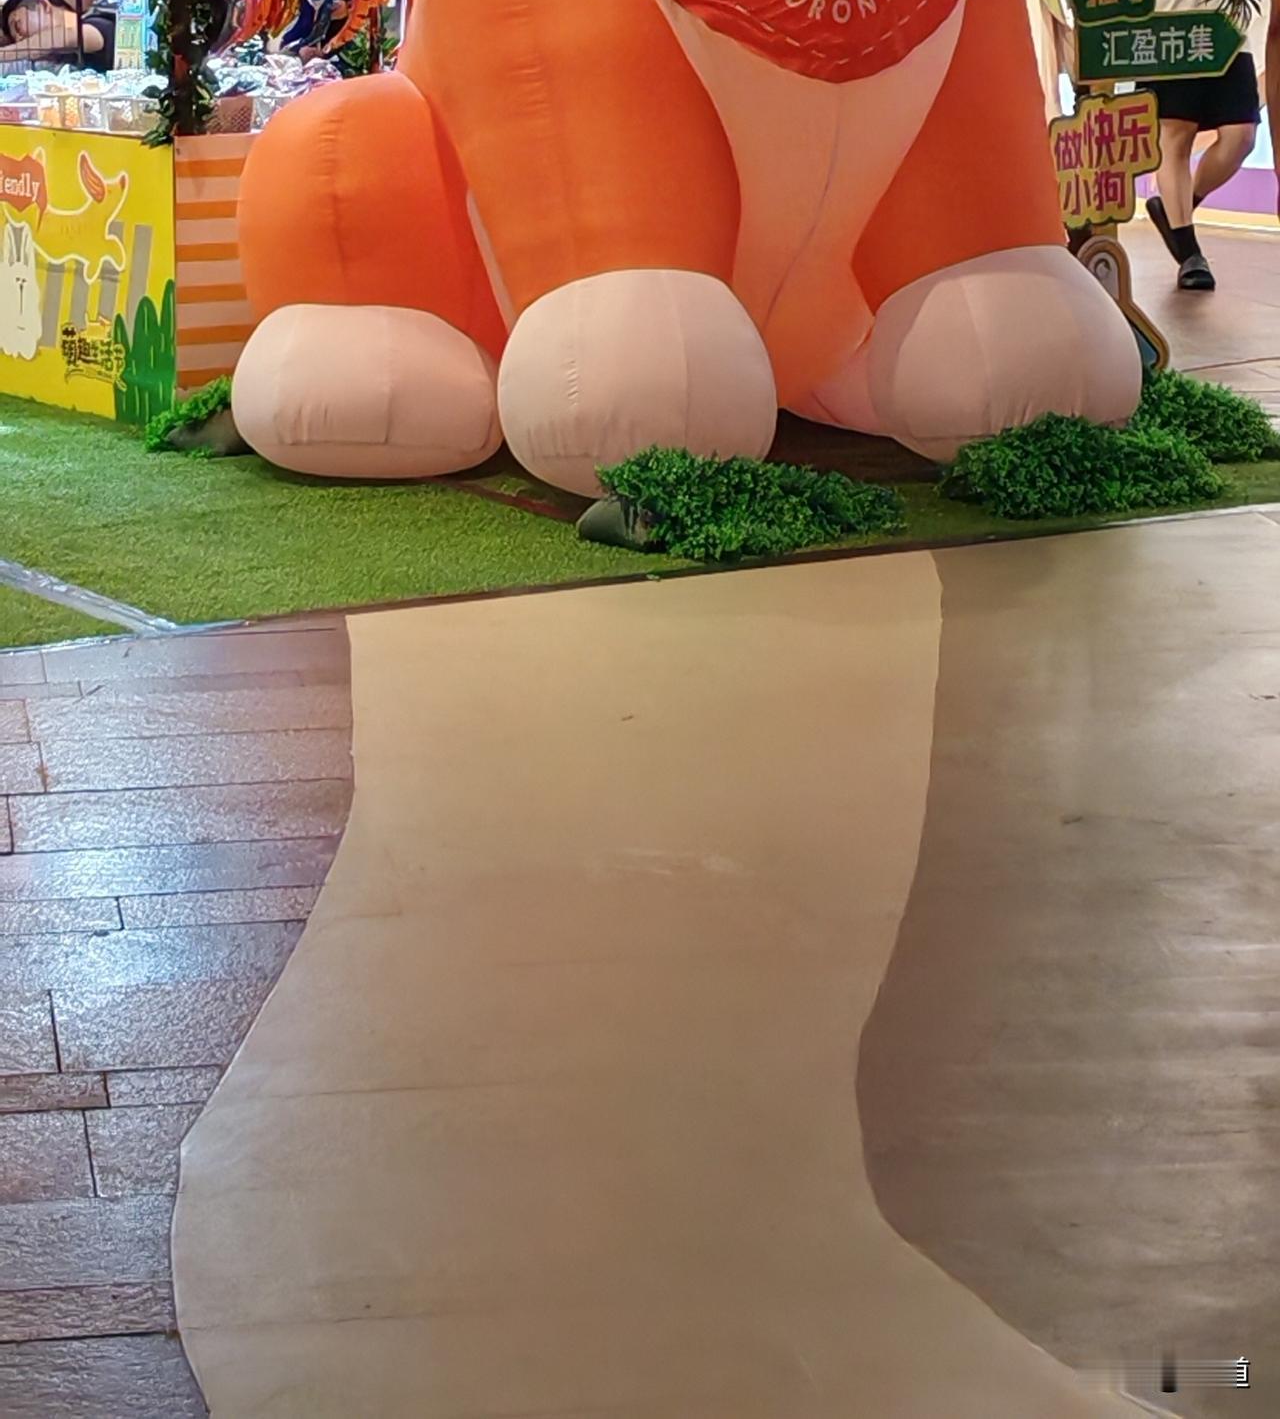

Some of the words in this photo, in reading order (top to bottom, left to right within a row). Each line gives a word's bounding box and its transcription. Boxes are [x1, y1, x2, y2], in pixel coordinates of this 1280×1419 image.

[1102, 24, 1215, 67] 汇盈市集
[1054, 104, 1152, 172] 做快乐
[1063, 170, 1126, 216] 小狗
